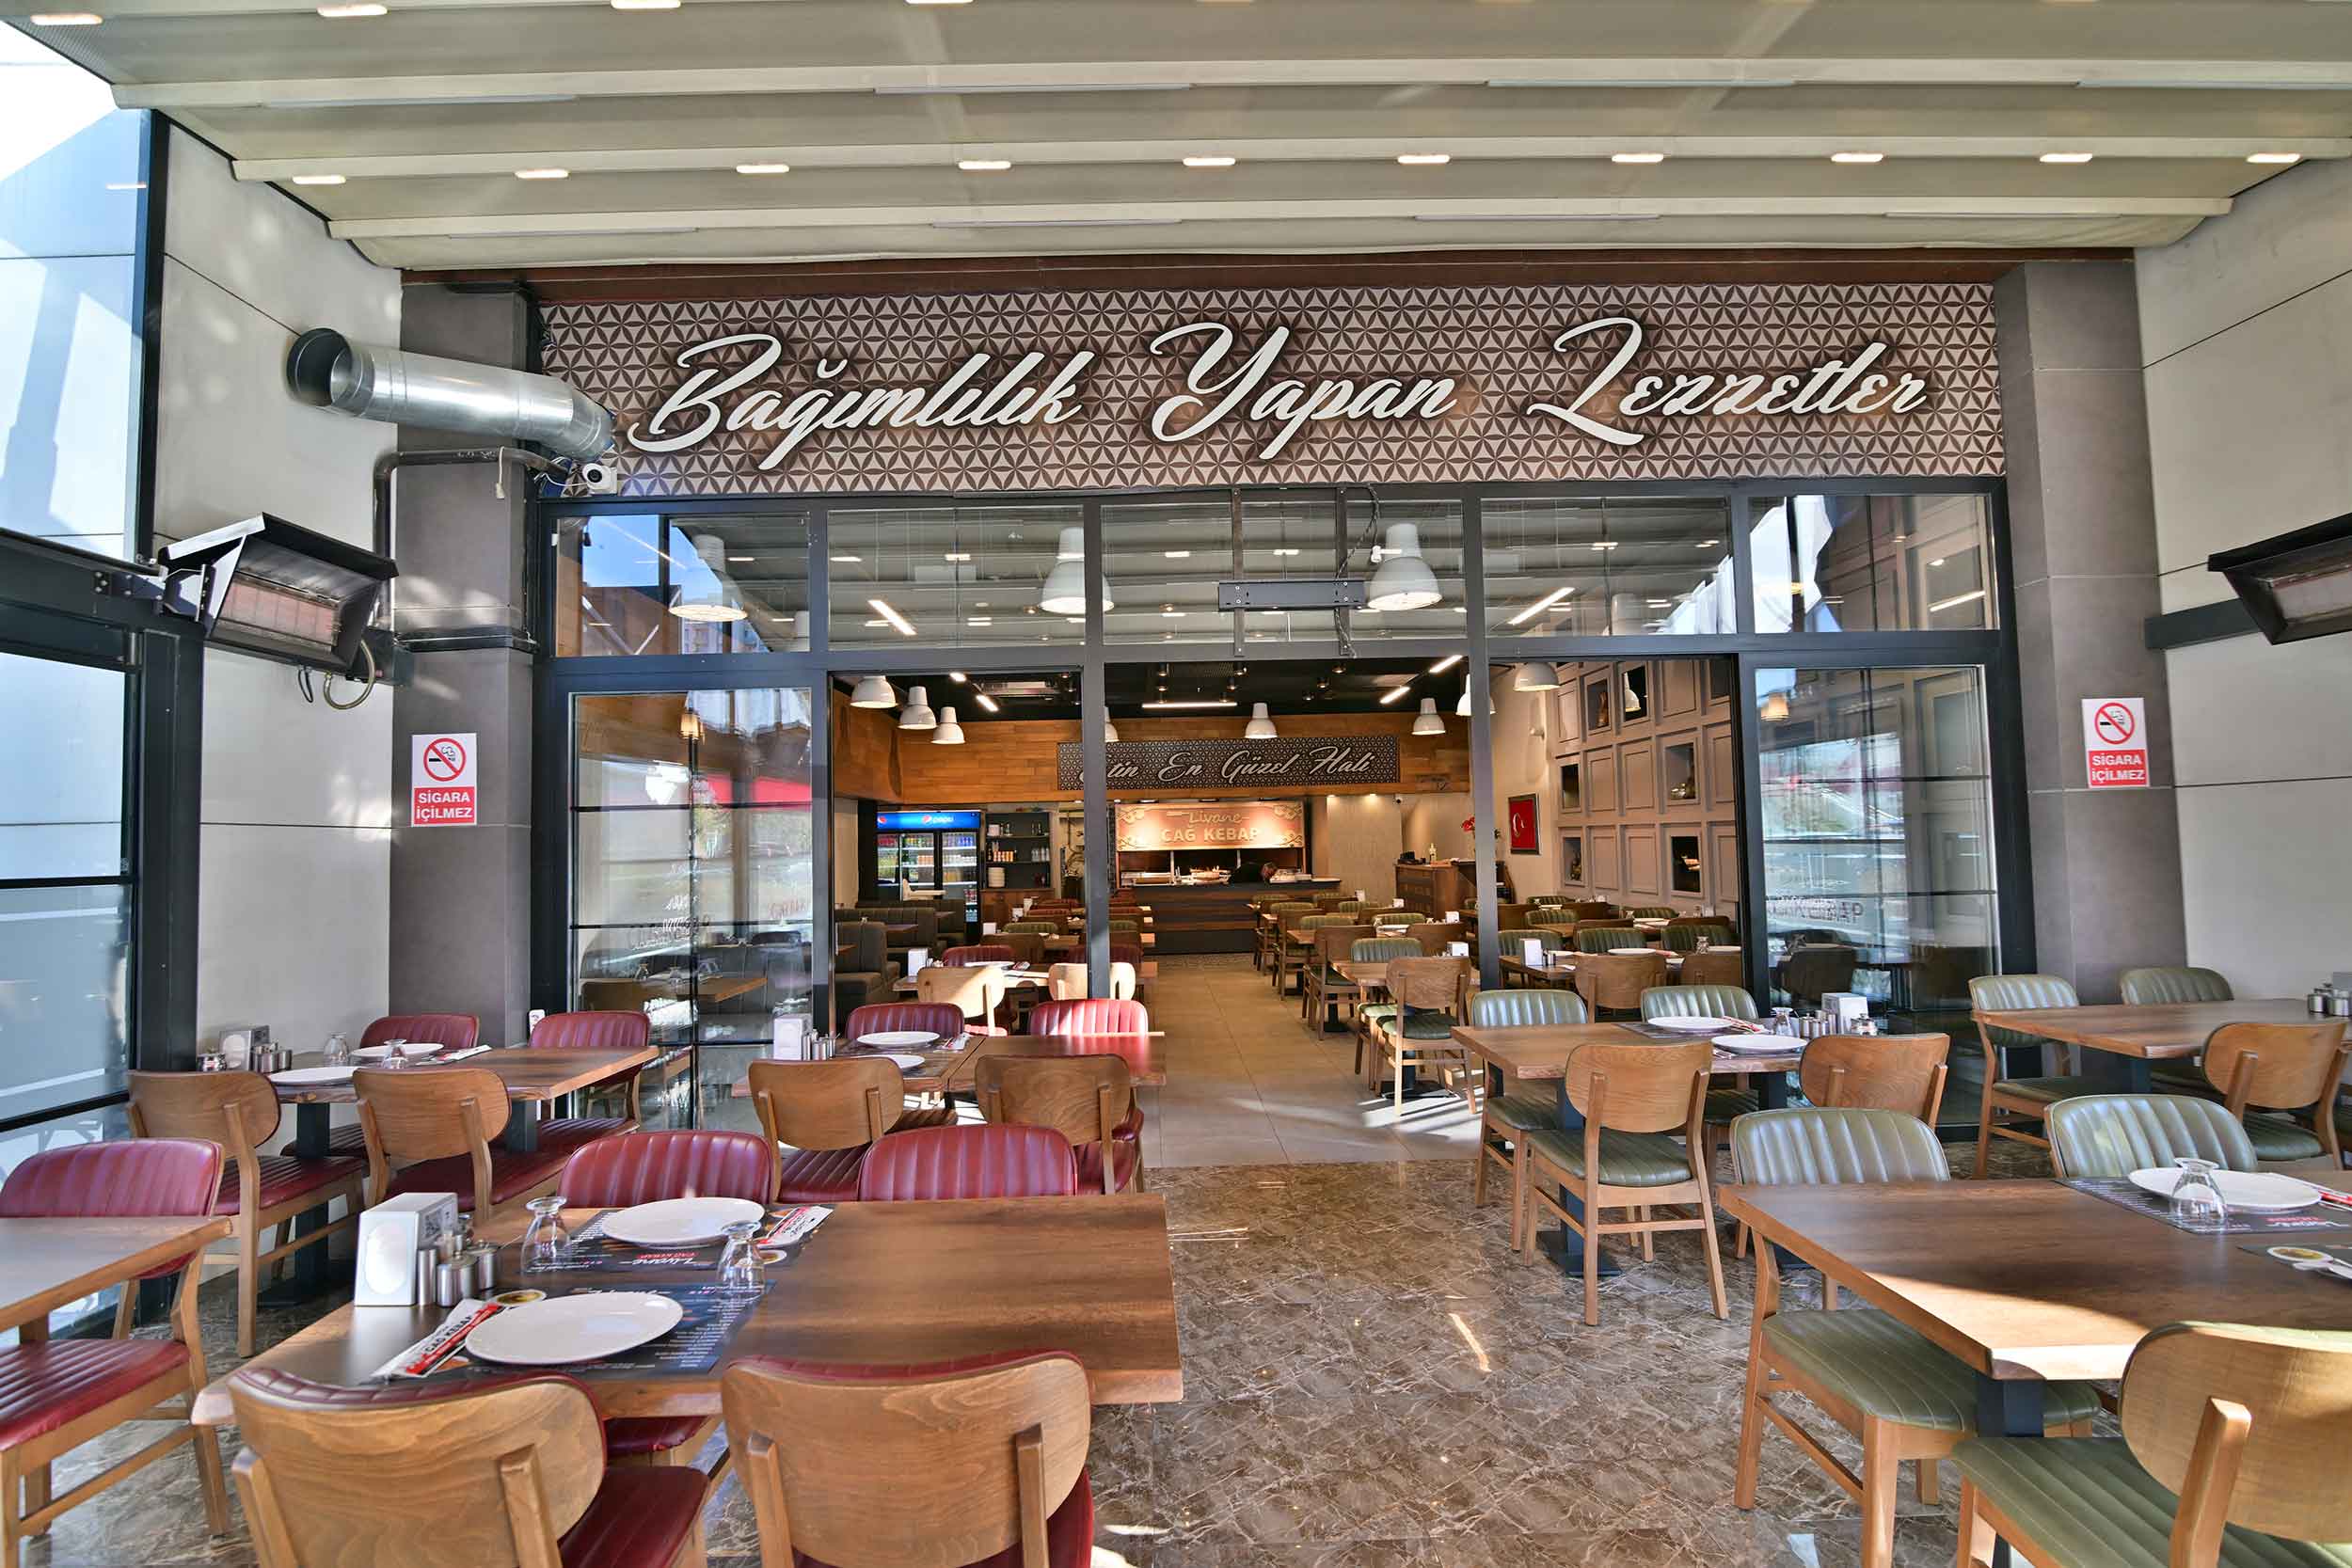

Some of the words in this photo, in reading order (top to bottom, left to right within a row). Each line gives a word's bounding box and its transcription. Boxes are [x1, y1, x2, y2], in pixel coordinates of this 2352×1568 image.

[628, 333, 1096, 470] Bağımlılık
[1151, 322, 1458, 461] Yapan
[1526, 316, 1927, 447] Lezzetler
[1157, 752, 1203, 782] En
[1221, 750, 1300, 784] Güzel
[1309, 746, 1375, 775] Hali
[2091, 752, 2142, 767] SİGARA
[2091, 768, 2145, 784] İÇİLMEZ
[418, 789, 470, 804] SİGARA
[416, 805, 473, 822] İÇİLMEZ
